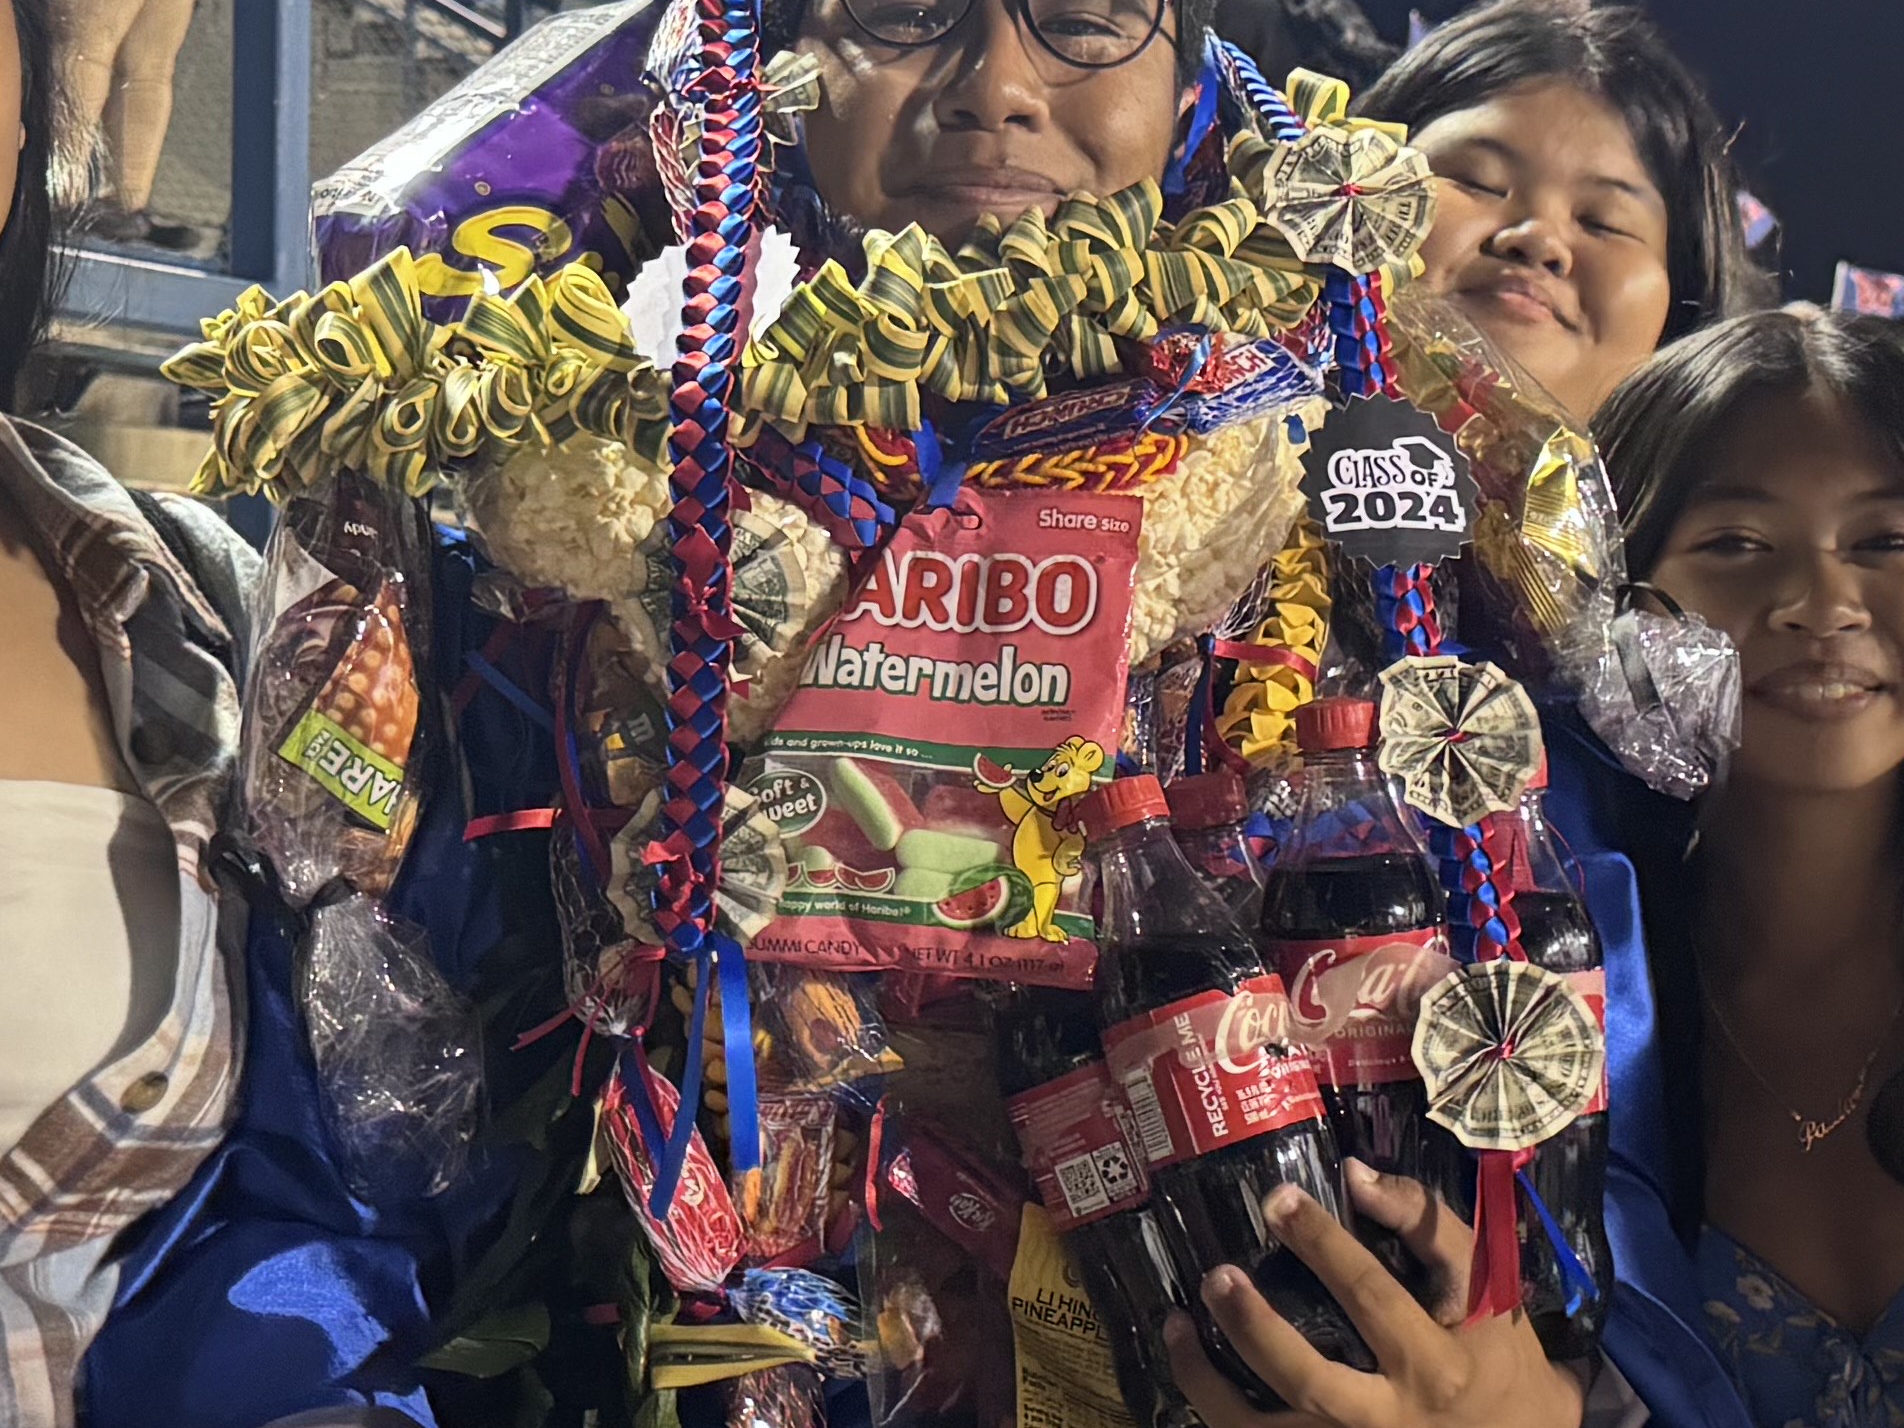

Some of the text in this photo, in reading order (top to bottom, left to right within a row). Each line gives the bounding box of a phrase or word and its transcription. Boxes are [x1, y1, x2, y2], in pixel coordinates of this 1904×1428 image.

[1335, 455, 1438, 488] CLASS OF
[1039, 509, 1130, 533] Share Size
[1329, 491, 1458, 525] 2024
[848, 553, 1096, 634] ARIBO
[318, 739, 401, 816] HARE
[805, 938, 863, 957] CANDY
[1173, 1012, 1197, 1048] ME
[1187, 1046, 1229, 1138] RECYCLE
[1036, 1287, 1056, 1306] LI
[1011, 1296, 1108, 1341] PINEAPPL
